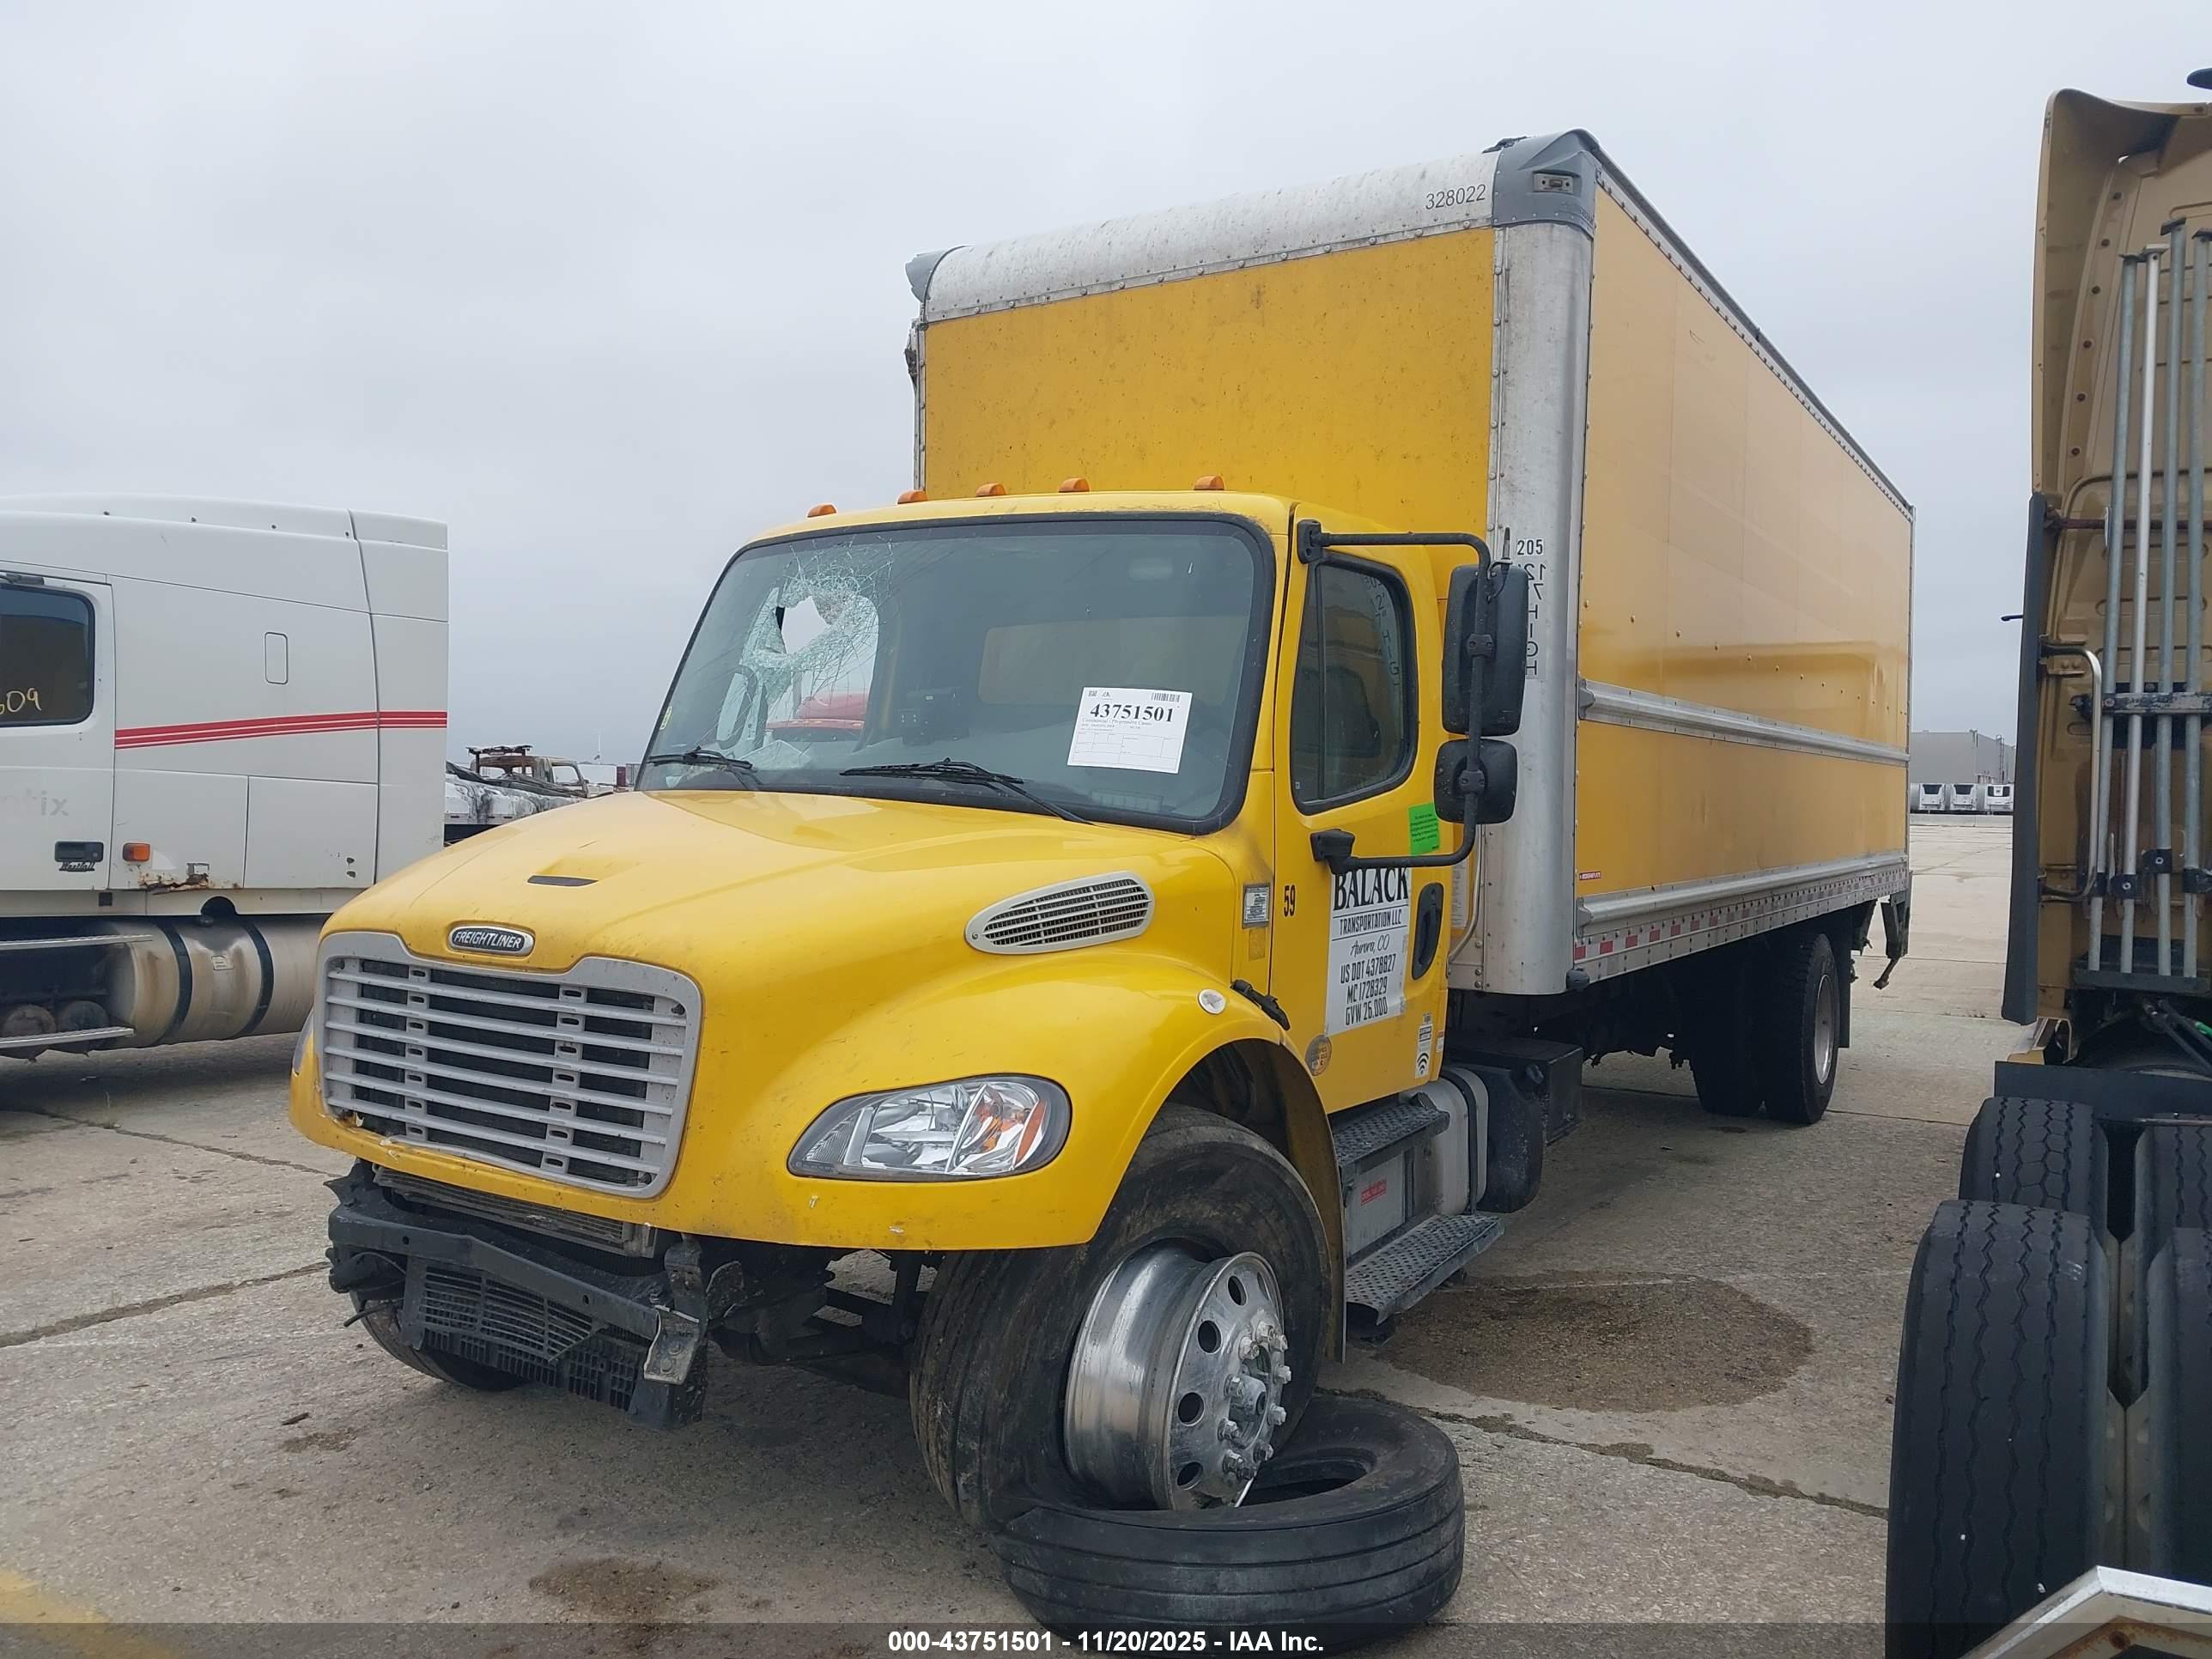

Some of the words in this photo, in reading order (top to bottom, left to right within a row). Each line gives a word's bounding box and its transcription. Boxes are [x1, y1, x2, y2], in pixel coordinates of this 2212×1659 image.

[1425, 184, 1486, 210] 328022
[1516, 538, 1543, 556] 205
[1090, 703, 1174, 722] 43751501
[1283, 884, 1296, 917] 59
[1333, 867, 1409, 911] BALACK
[1340, 912, 1391, 936] TRANSPORTATION
[1391, 909, 1402, 926] LLC
[453, 932, 521, 949] FREIGHTLINER
[1376, 934, 1390, 951] CO
[1340, 963, 1350, 984] US
[1351, 960, 1365, 981] DOT
[1347, 983, 1358, 1005] MC
[1359, 976, 1389, 1001] 1728329
[1346, 1003, 1362, 1025] GVW
